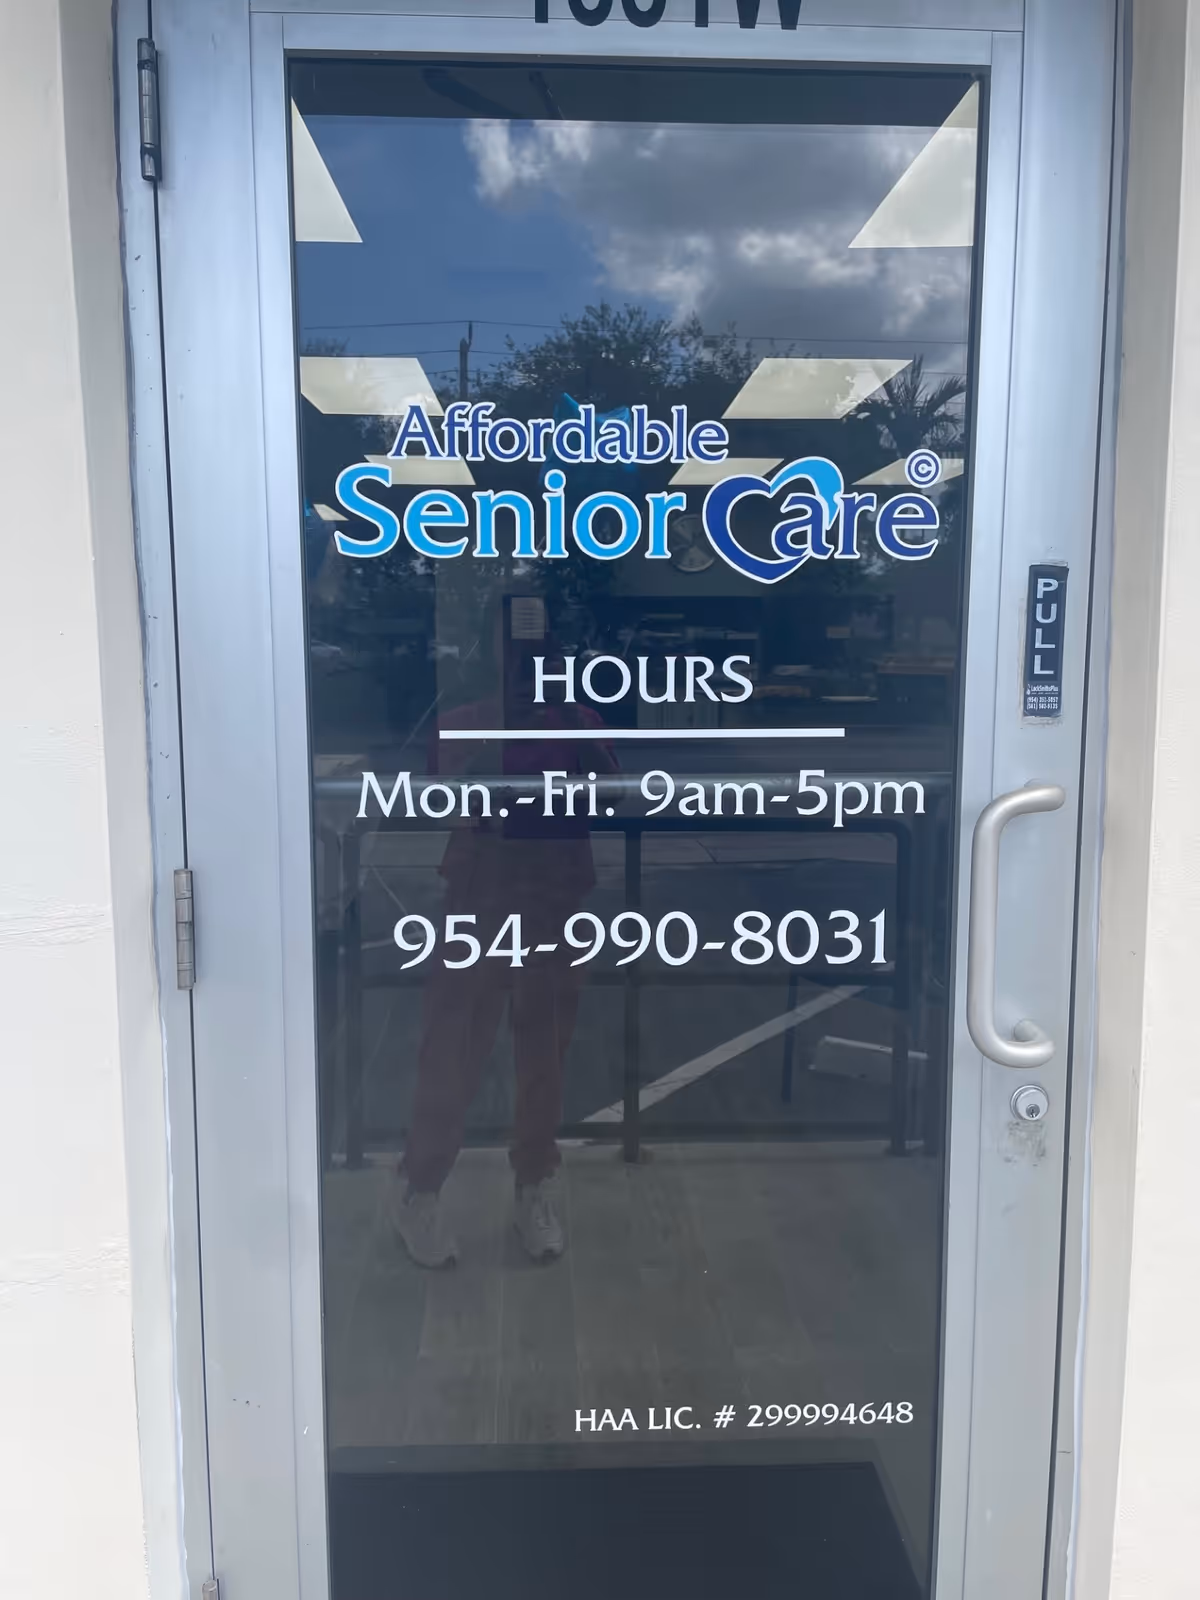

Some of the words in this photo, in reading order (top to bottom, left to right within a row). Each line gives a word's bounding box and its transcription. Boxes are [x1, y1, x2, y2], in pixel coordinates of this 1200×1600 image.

[387, 401, 729, 464] Affordable
[334, 462, 687, 561] Senior
[702, 455, 940, 584] Care
[1033, 578, 1059, 675] PULL
[533, 655, 753, 704] HOURS
[356, 771, 616, 818] Mon.-Fri.
[640, 769, 926, 828] 9am-5pm
[393, 908, 888, 970] 954-990-8031
[574, 1408, 640, 1432] HAA
[647, 1406, 702, 1430] LIC.
[713, 1404, 737, 1429] #
[746, 1401, 914, 1428] 299994648
